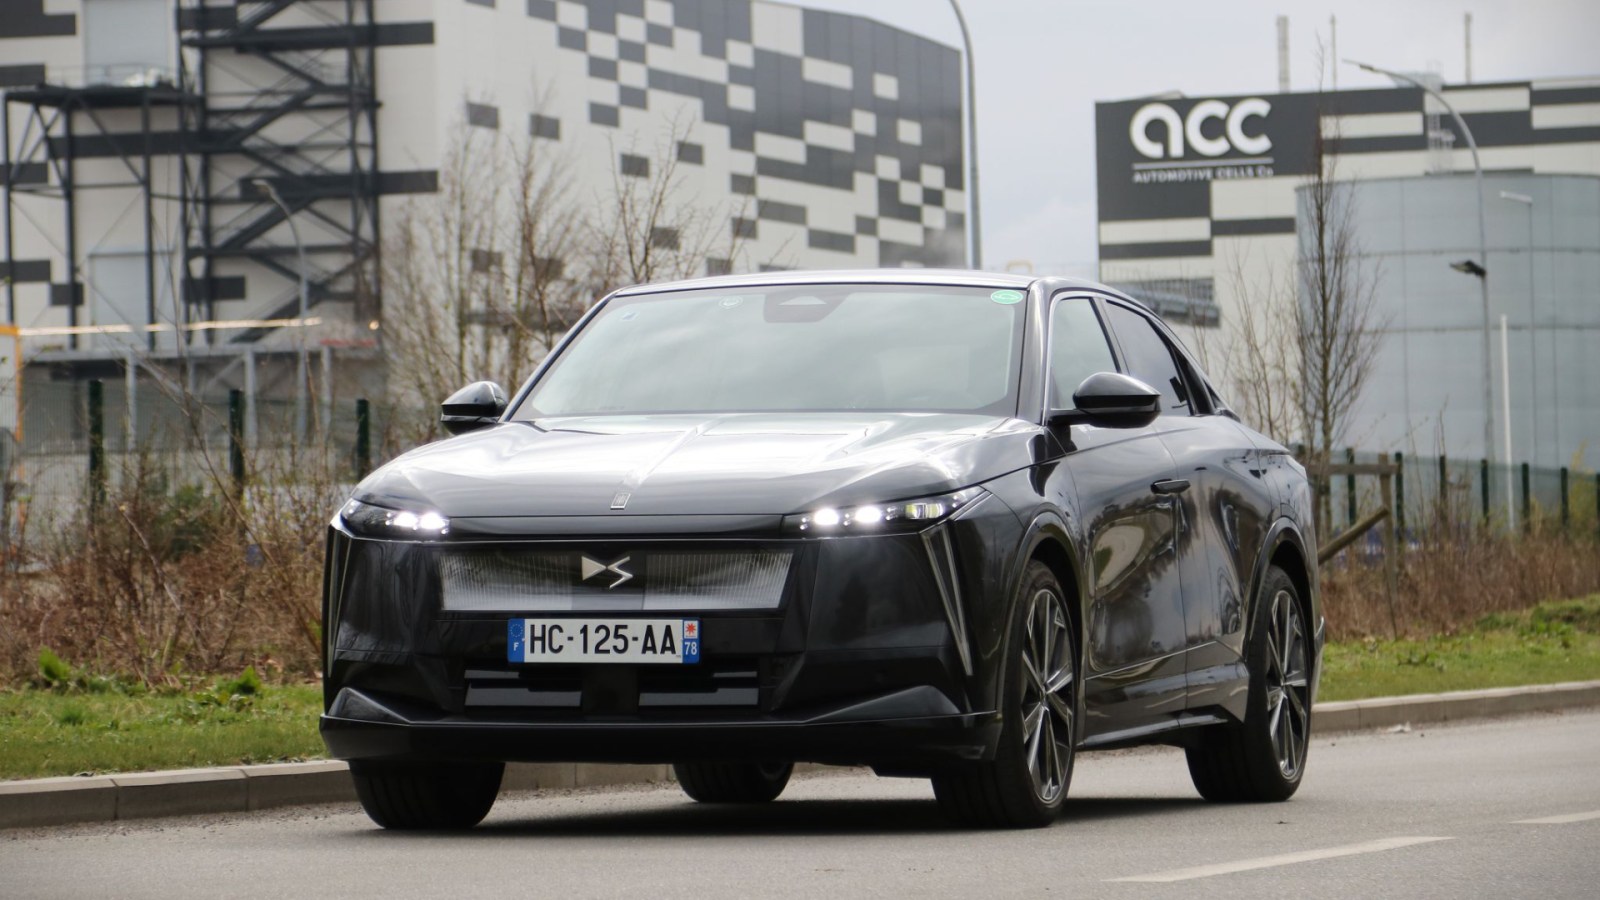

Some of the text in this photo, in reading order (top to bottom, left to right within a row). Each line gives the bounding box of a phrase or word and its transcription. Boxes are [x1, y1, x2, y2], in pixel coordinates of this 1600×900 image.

[1134, 168, 1212, 183] AUTOMOTIVE
[1216, 167, 1254, 178] CELLS
[513, 642, 519, 651] F
[530, 624, 677, 655] HC-125-AA
[684, 641, 697, 655] 78
